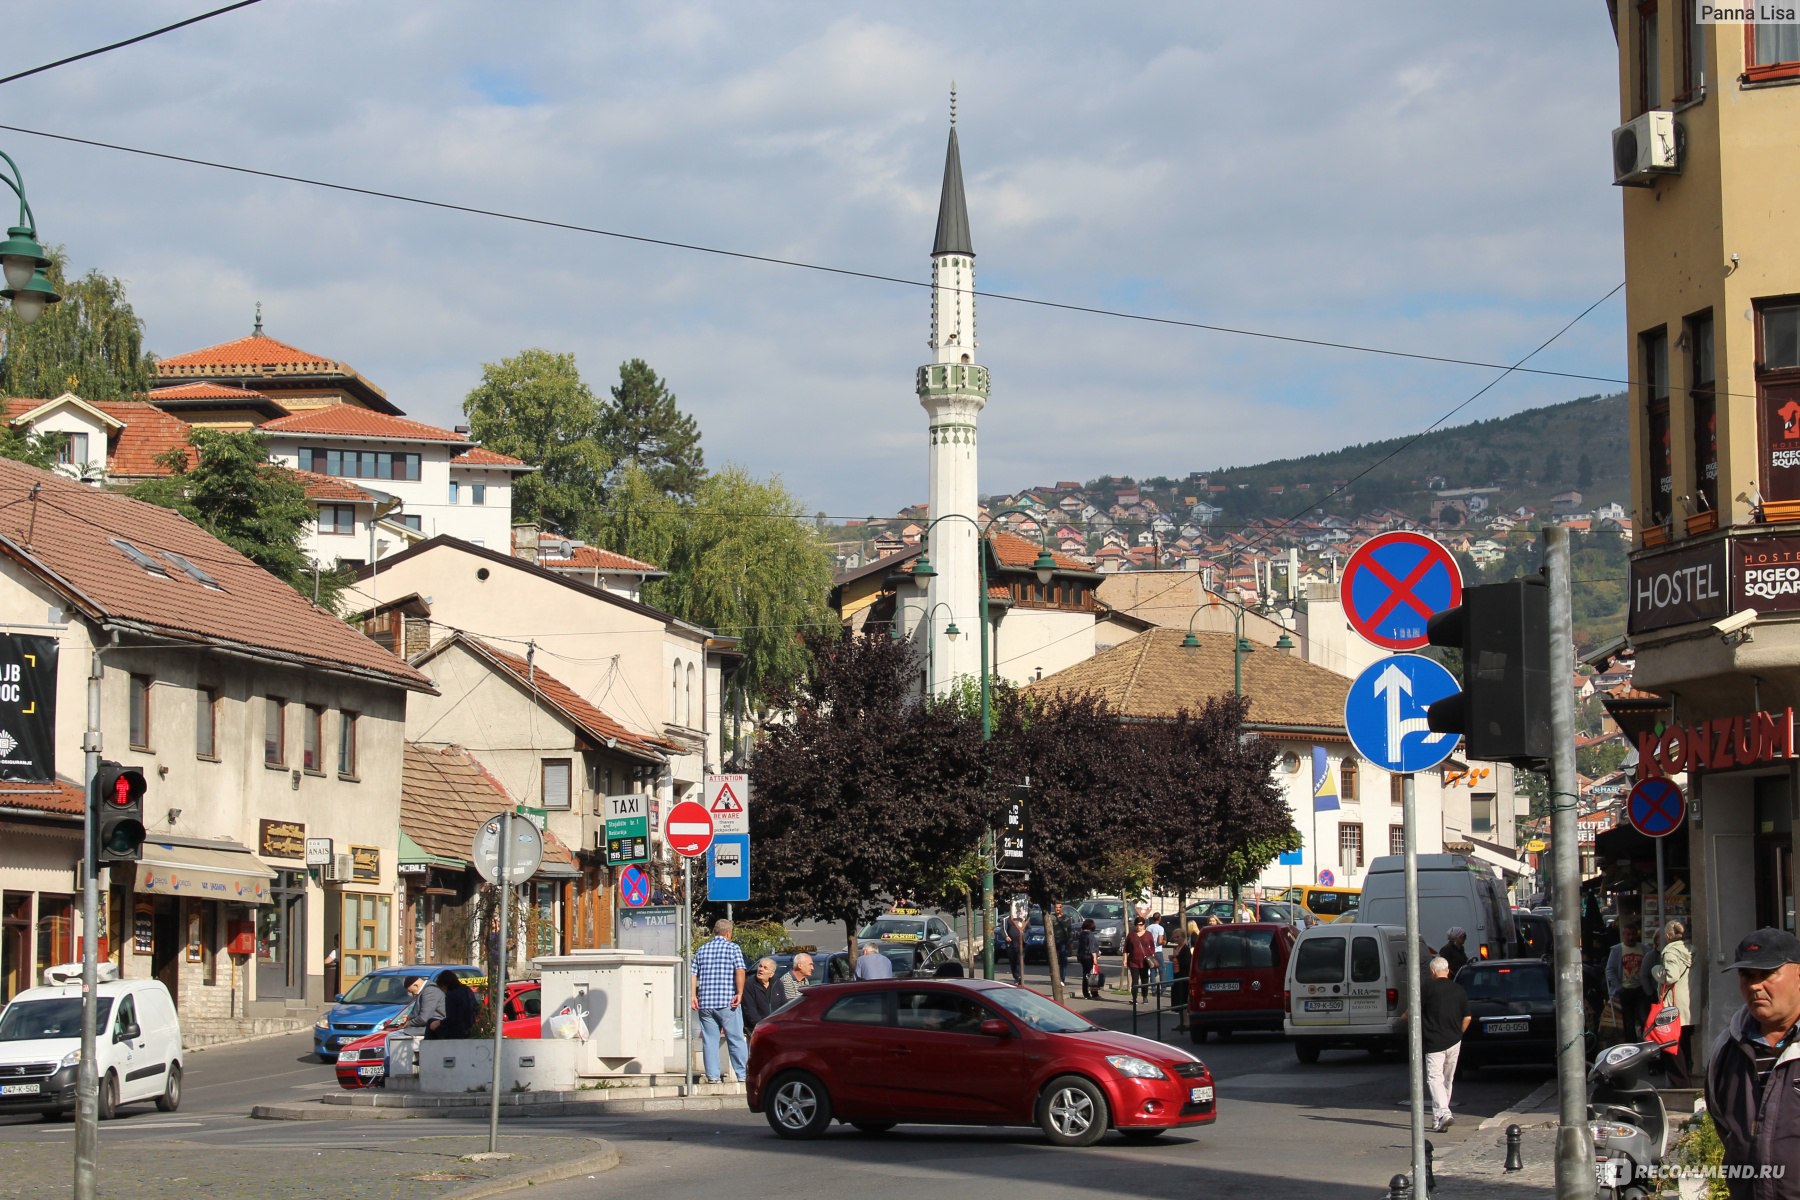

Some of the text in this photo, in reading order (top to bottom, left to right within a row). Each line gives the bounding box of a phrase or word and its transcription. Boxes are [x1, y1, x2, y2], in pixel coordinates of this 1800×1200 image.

[1745, 567, 1800, 583] PIGEO
[1637, 563, 1720, 612] HOSTEL
[1638, 707, 1794, 780] KONZUM
[612, 798, 639, 814] TAXI
[308, 848, 330, 856] ANAIS
[398, 863, 427, 873] MOBILE
[645, 915, 667, 926] TAXI
